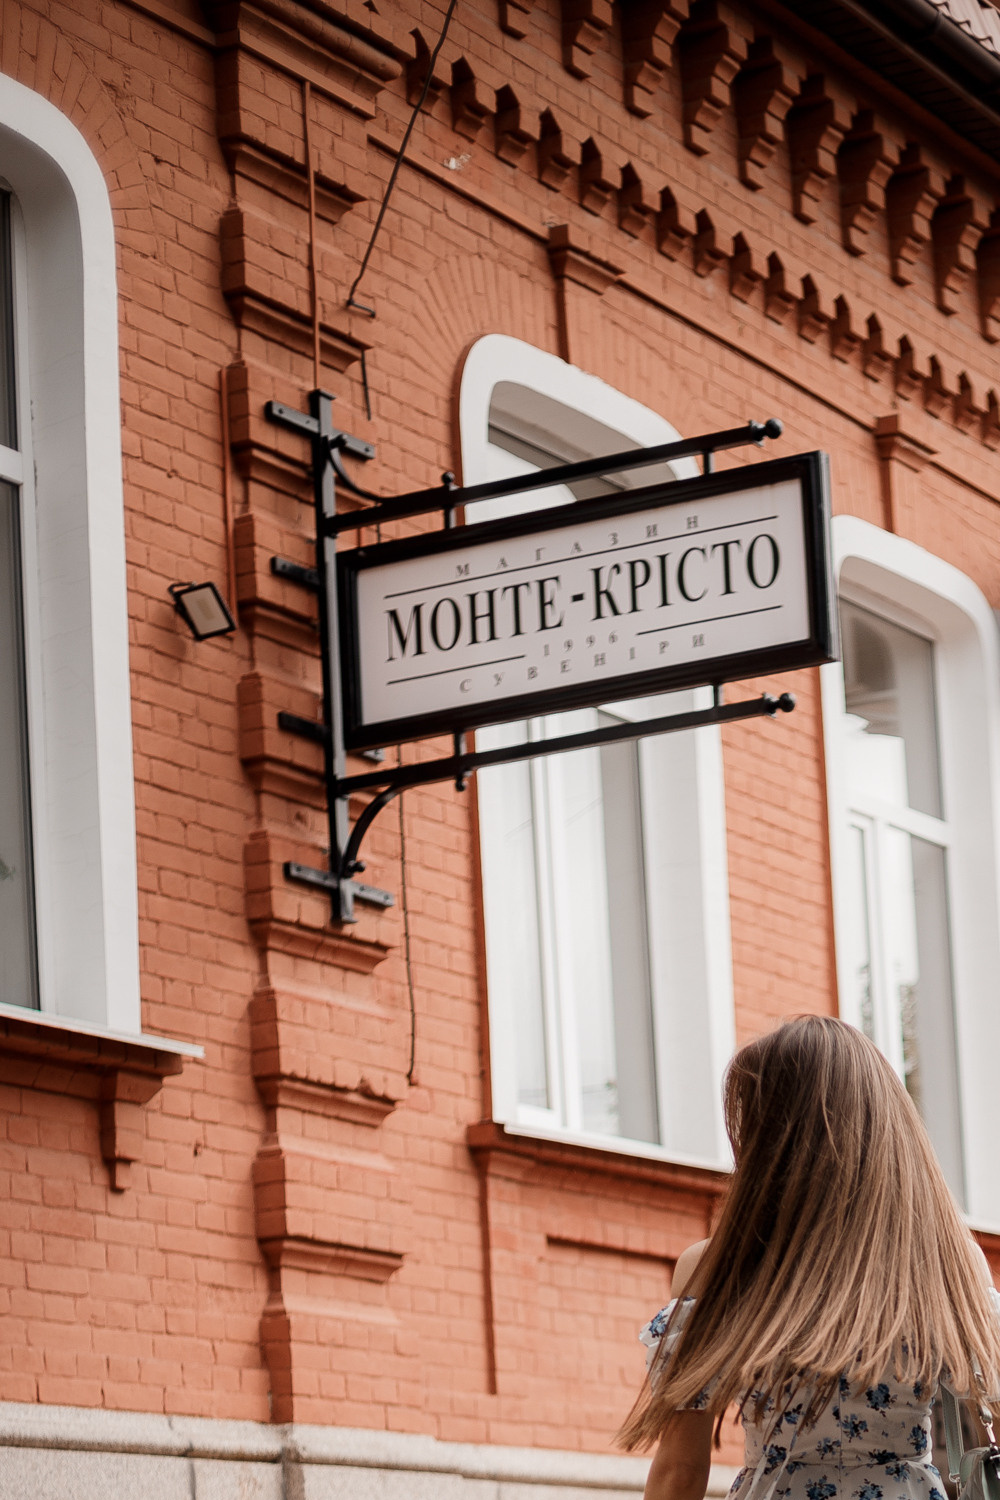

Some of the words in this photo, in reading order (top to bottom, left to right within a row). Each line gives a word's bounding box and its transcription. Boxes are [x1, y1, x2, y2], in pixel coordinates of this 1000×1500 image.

[456, 516, 699, 577] МАГАЗИН
[385, 533, 782, 663] МОНТЕ-КРІСТО
[459, 633, 706, 694] СУВЕНІРИ
[544, 630, 619, 656] 1996
